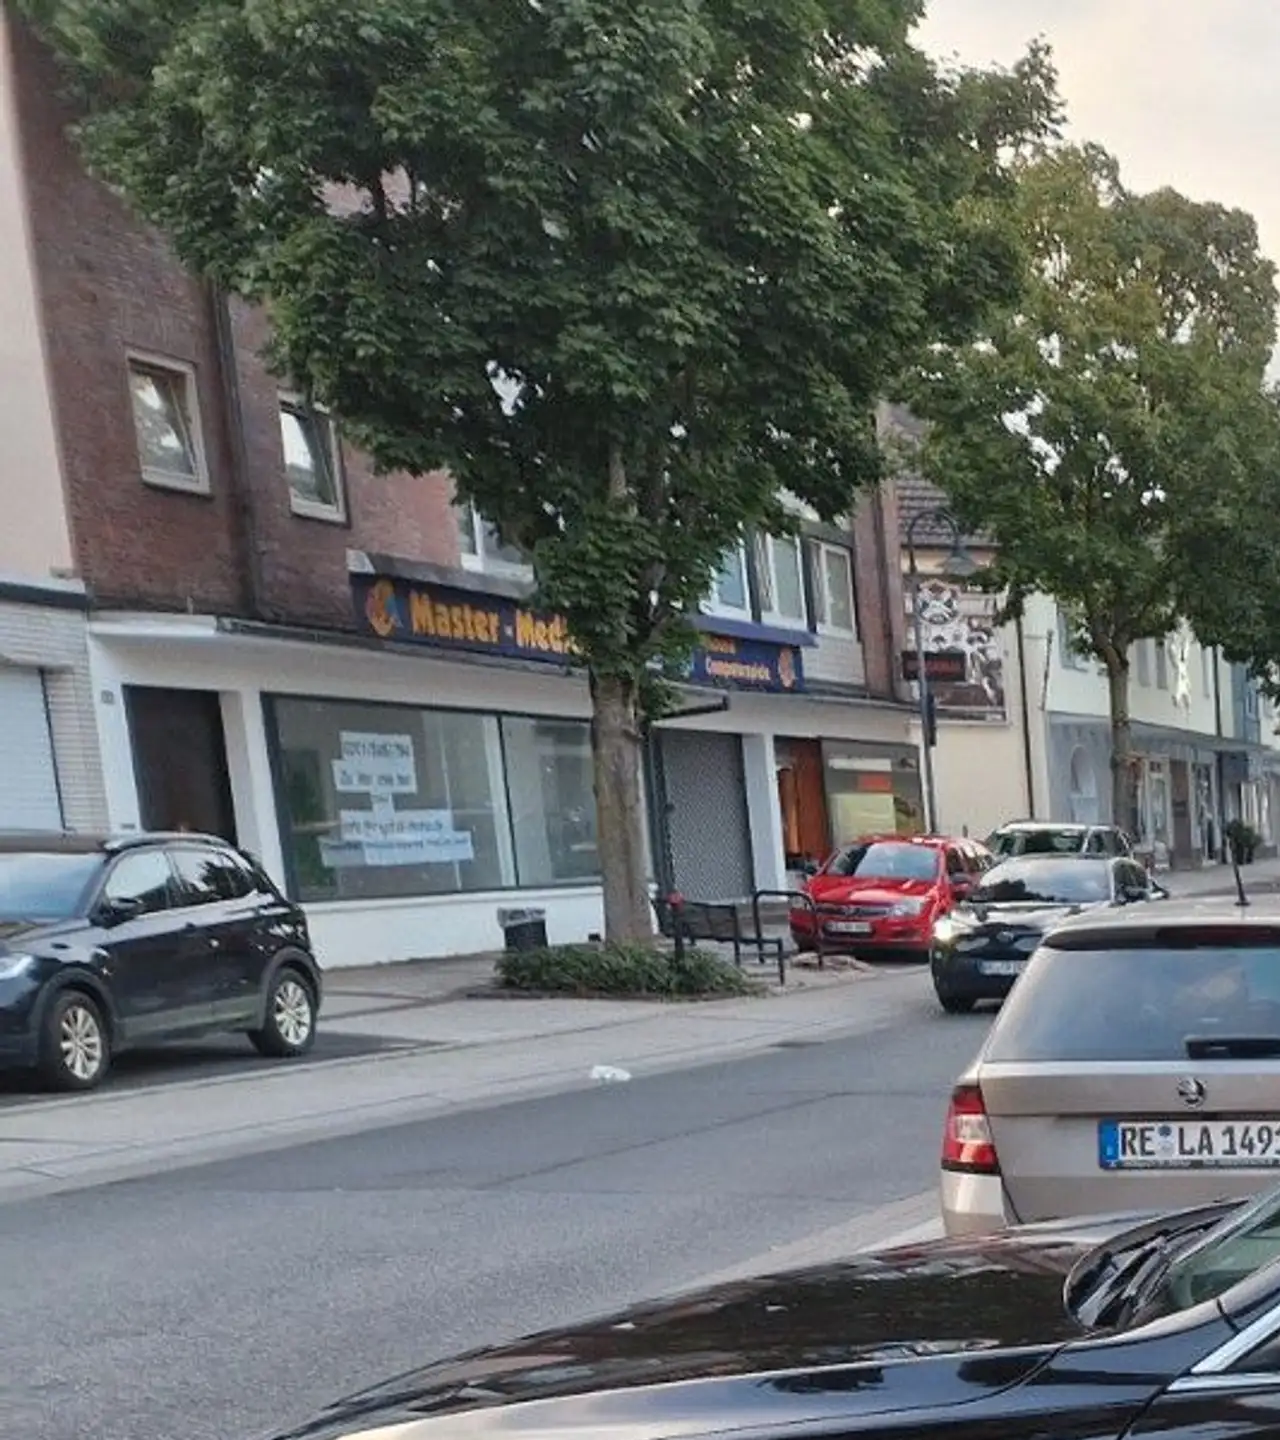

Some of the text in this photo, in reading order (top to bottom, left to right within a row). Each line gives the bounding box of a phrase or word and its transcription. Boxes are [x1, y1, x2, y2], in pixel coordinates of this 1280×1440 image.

[409, 590, 499, 644] Master
[1121, 1125, 1155, 1156] RE
[1179, 1125, 1213, 1156] LA
